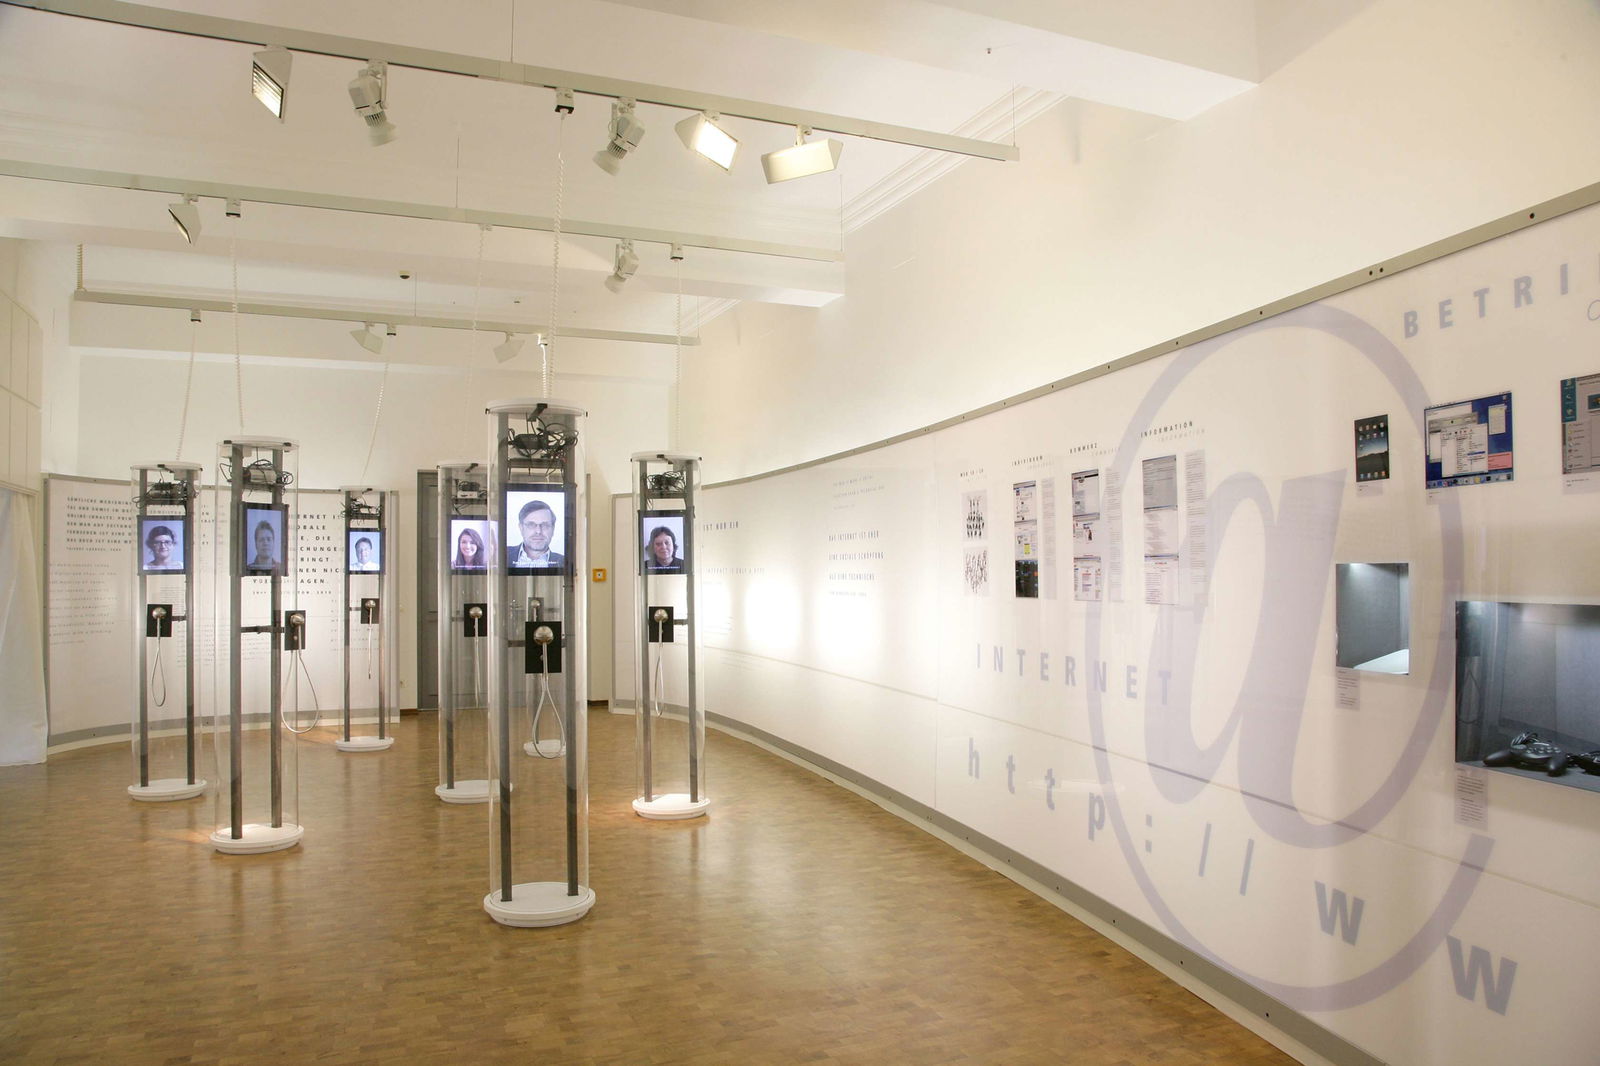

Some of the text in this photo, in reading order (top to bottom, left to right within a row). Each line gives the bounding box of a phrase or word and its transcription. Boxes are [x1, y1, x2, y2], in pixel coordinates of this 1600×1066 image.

[1403, 252, 1600, 340] BETRI
[1140, 420, 1193, 438] INFORMATION
[1069, 442, 1098, 454] KOMMERZ
[837, 532, 857, 541] INTERNET
[976, 643, 1172, 706] INTERNET
